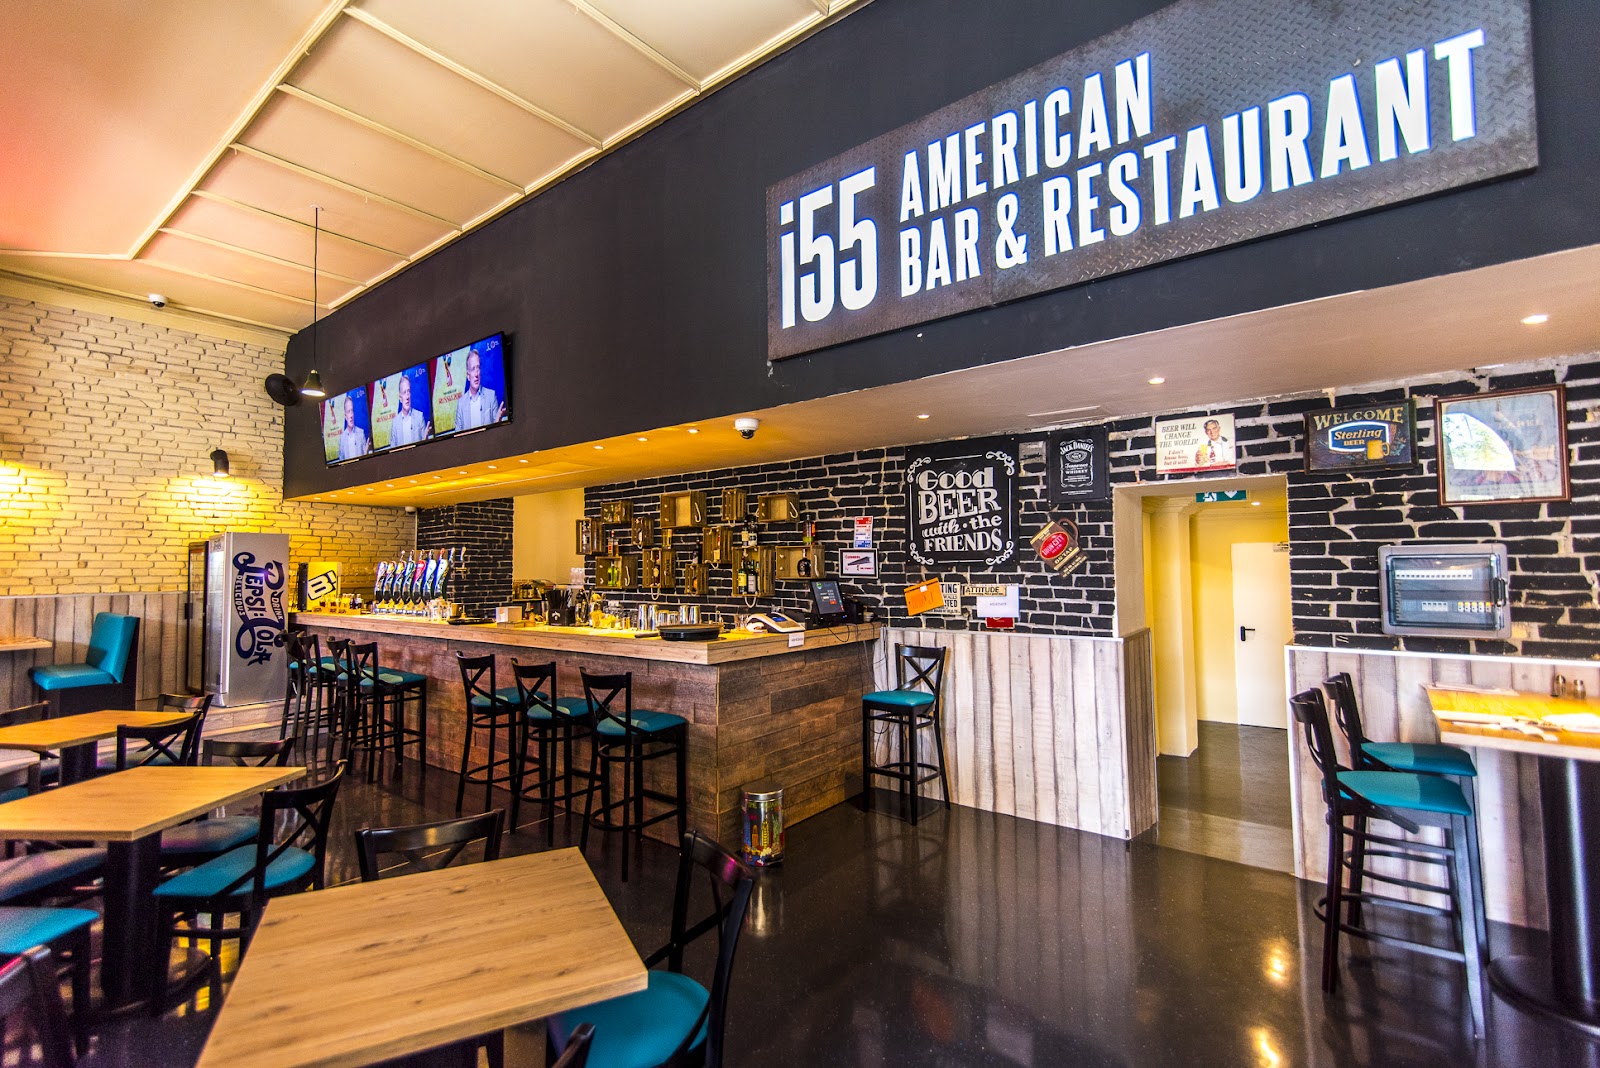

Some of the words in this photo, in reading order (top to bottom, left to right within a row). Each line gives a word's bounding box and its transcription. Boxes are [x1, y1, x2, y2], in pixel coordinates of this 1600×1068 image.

[900, 52, 1153, 223] AMERICAN
[900, 205, 980, 298] BAR
[995, 202, 1028, 269] &
[1043, 28, 1486, 257] RESTAURANT
[780, 166, 877, 329] i55
[1161, 425, 1179, 433] BEER
[1180, 423, 1197, 431] WILL
[1313, 407, 1404, 431] WELCOME
[1159, 440, 1173, 448] THE
[1164, 431, 1192, 440] CHANGE
[1334, 429, 1383, 440] Sterling
[1060, 444, 1074, 455] JACK
[916, 467, 994, 490] Good
[918, 488, 1002, 525] BEER
[922, 519, 961, 537] with
[969, 515, 1002, 530] the
[924, 528, 1003, 552] FRIENDS
[1052, 533, 1065, 546] CITY
[234, 574, 246, 616] DELICIOUS
[941, 583, 957, 593] TING
[272, 597, 284, 620] DRINK
